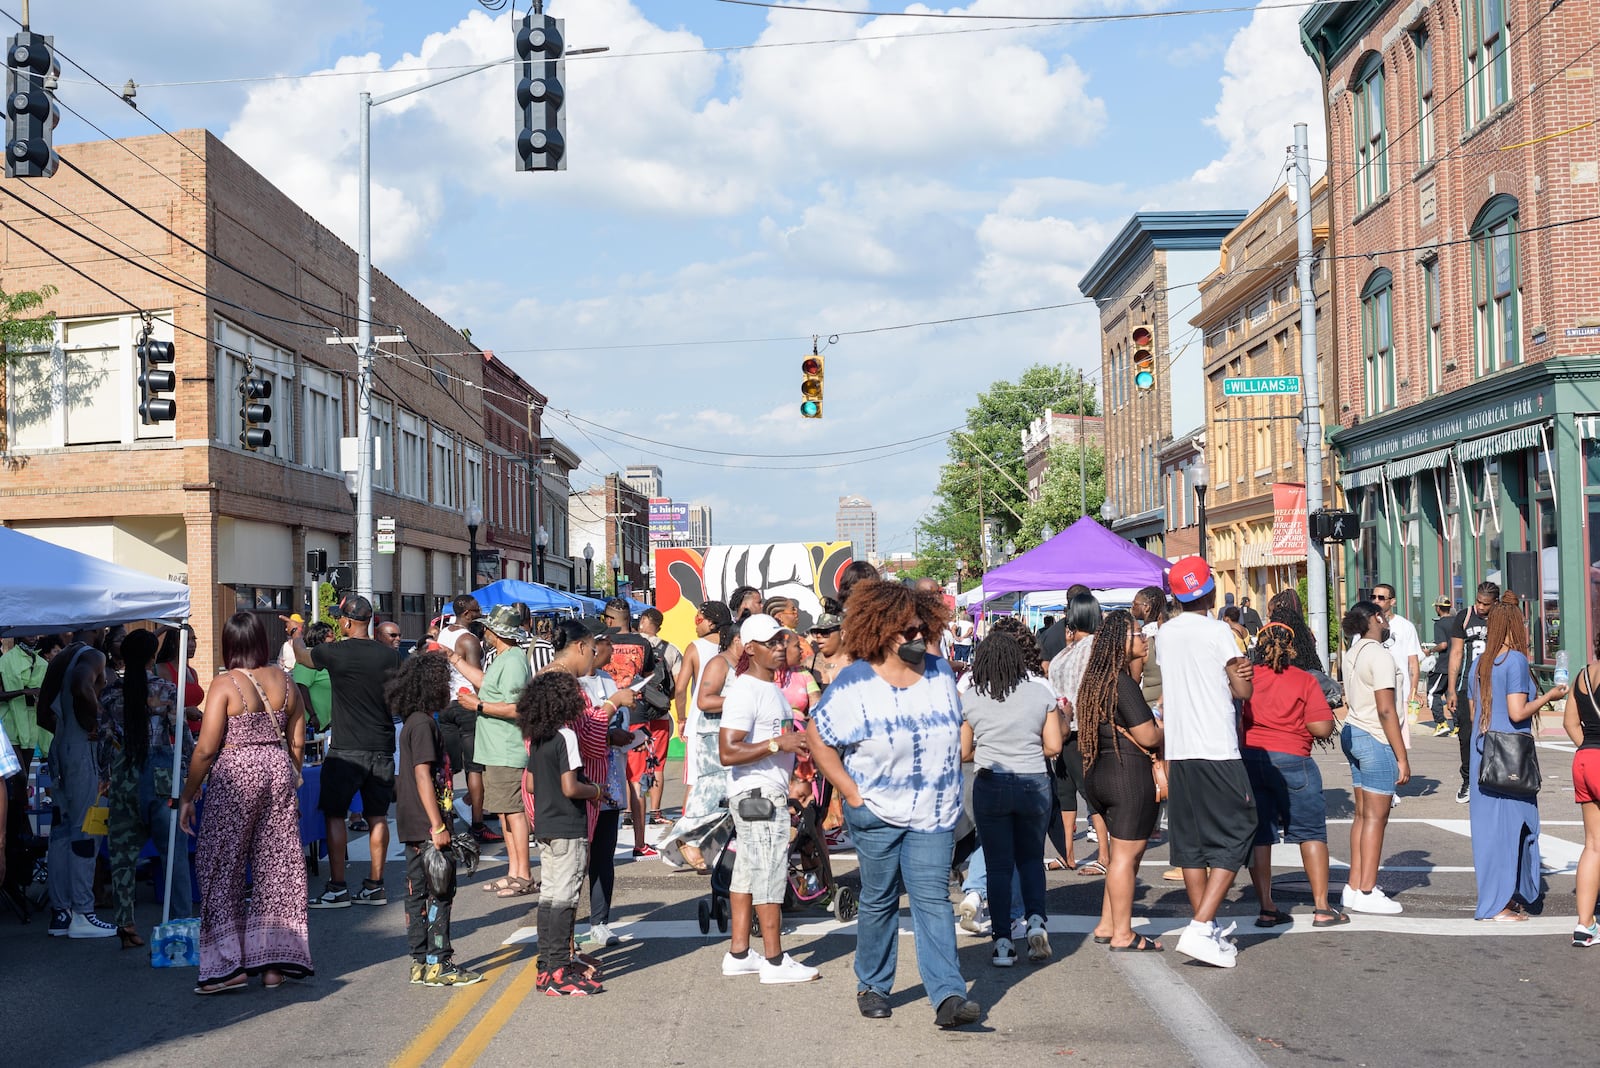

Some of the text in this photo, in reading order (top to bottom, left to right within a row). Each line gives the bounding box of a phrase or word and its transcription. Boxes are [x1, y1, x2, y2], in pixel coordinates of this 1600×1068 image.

[1231, 380, 1286, 393] WILLIAMS
[1352, 397, 1532, 464] DAYTON AVIATION HERITAGE NATIONAL HISTORICAL PARK
